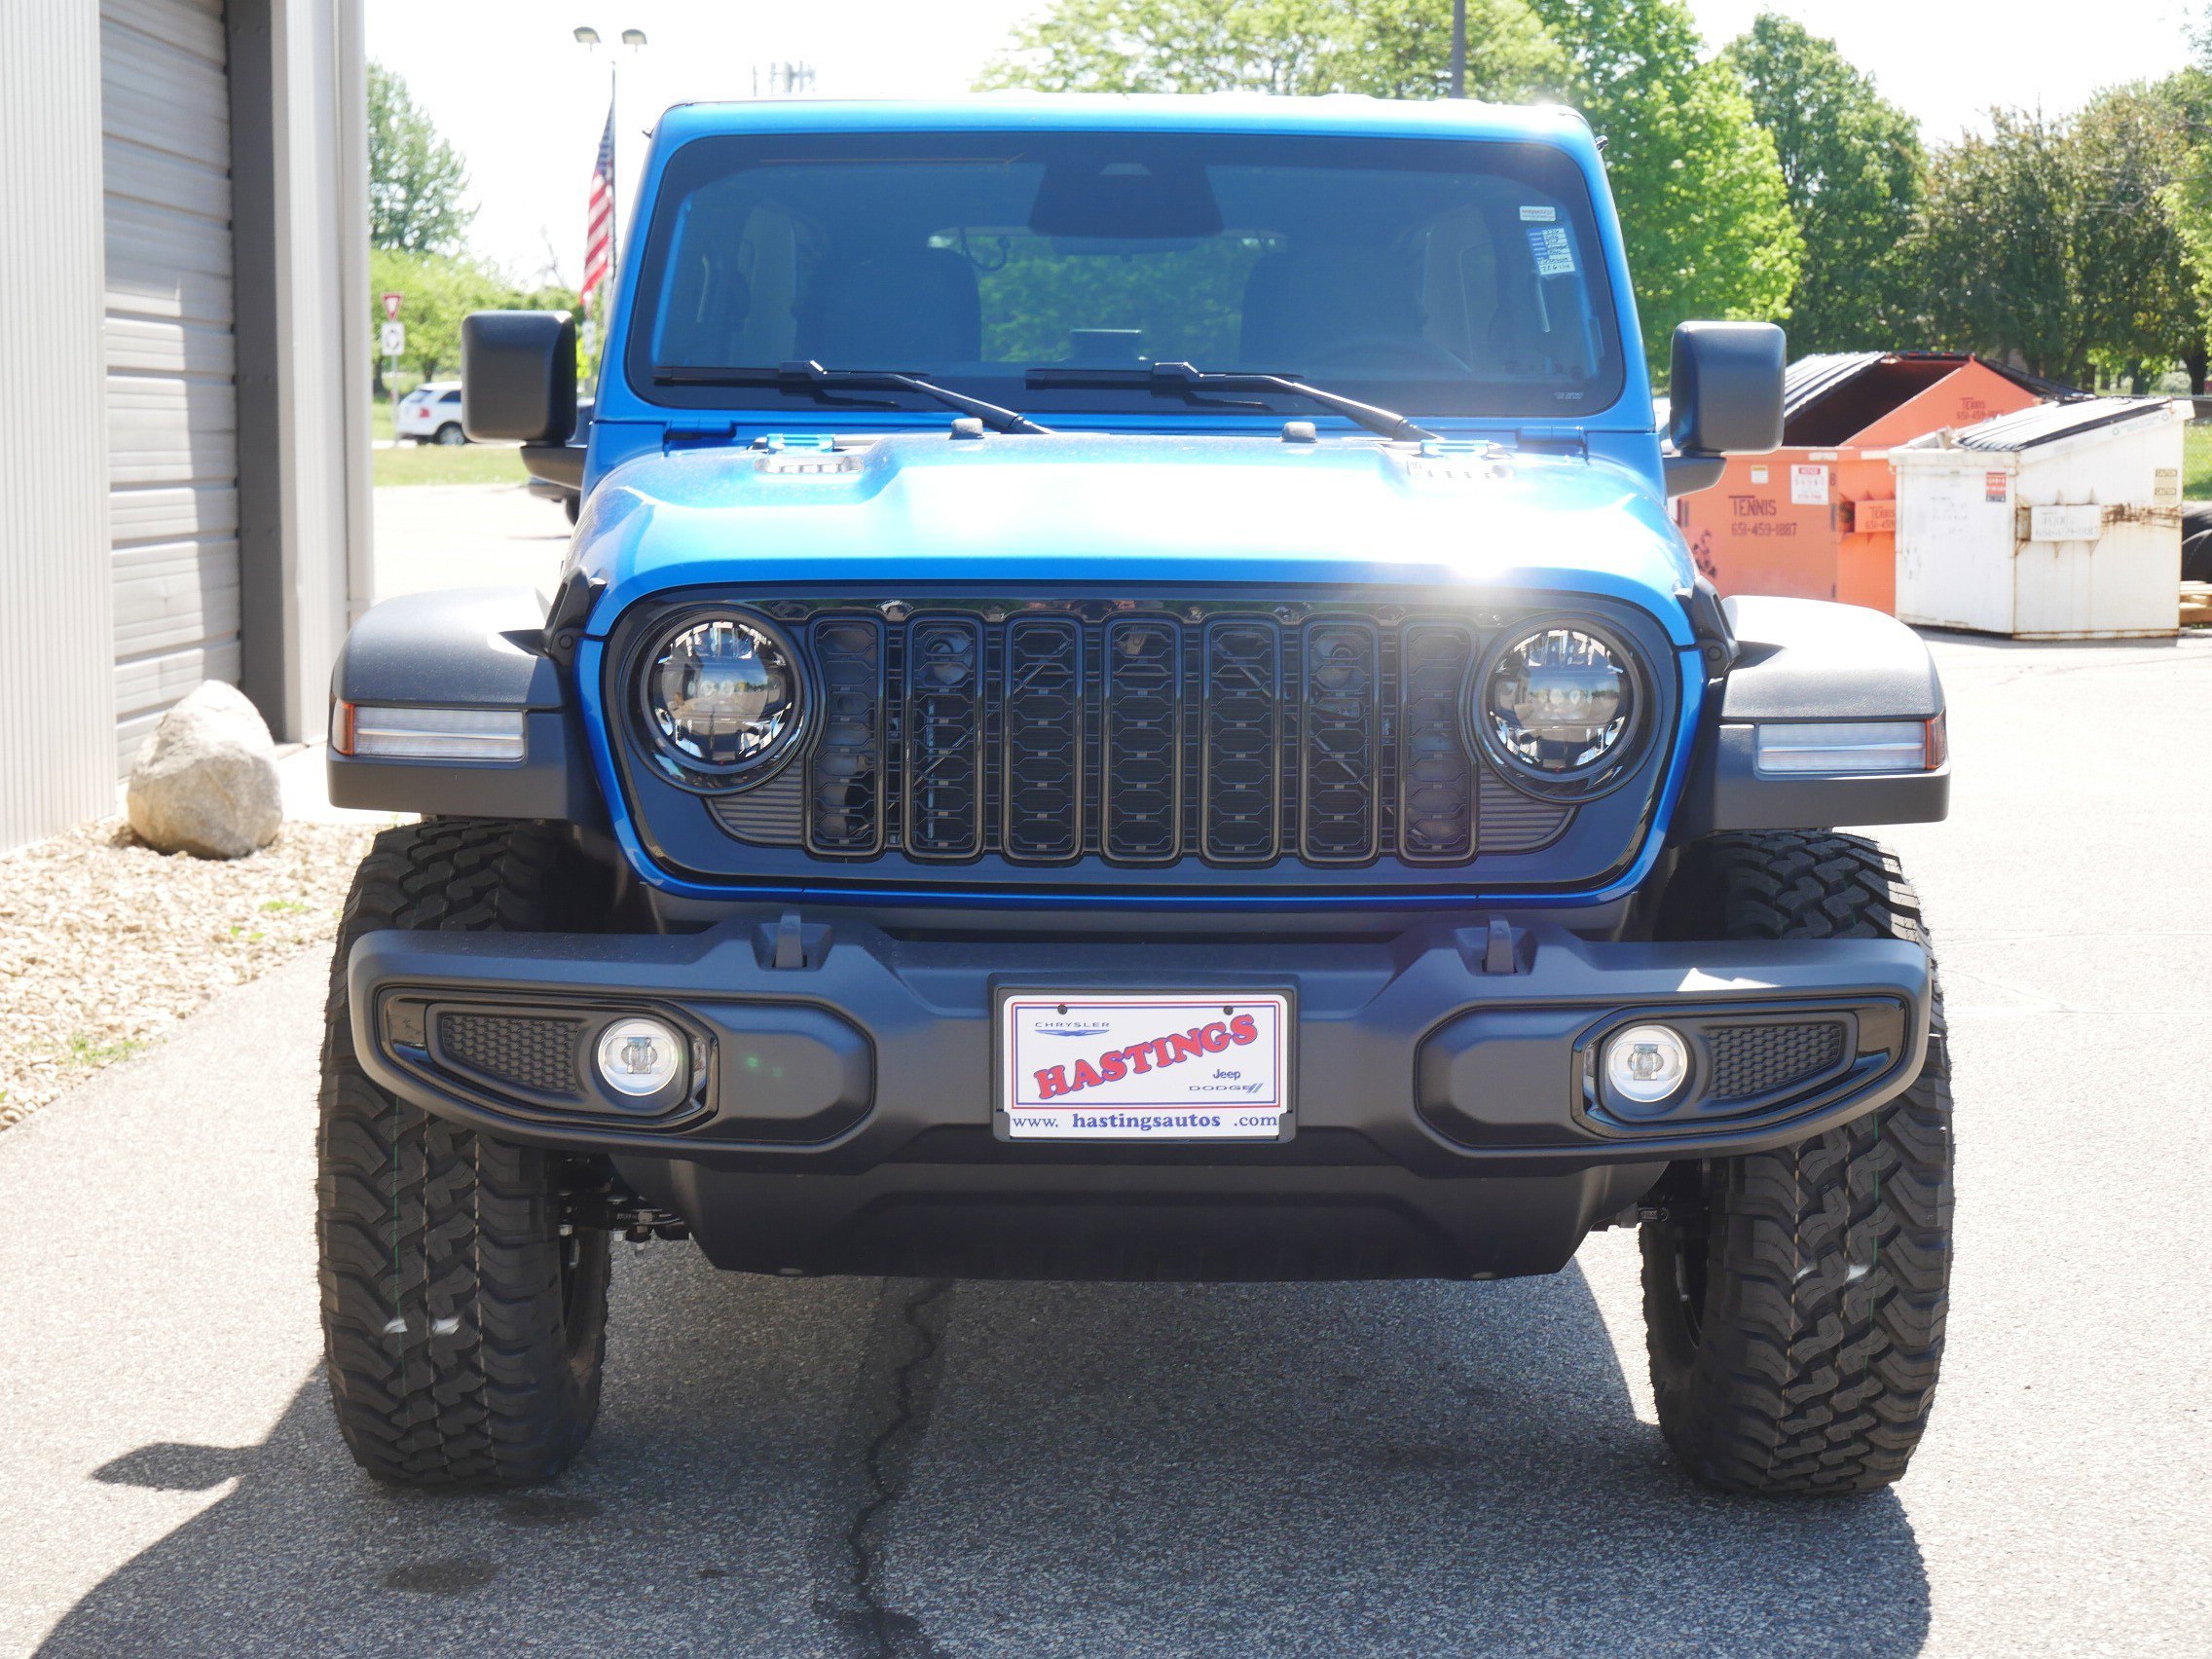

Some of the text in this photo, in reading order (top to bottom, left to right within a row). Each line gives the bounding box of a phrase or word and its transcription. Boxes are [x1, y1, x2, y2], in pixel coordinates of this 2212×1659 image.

[1728, 496, 1777, 516] TENNIS
[1731, 522, 1797, 536] 651-459-1887
[1034, 1014, 1258, 1099] HASTINGS
[1213, 1069, 1240, 1080] Jeep
[1072, 1113, 1221, 1131] hastingsautos
